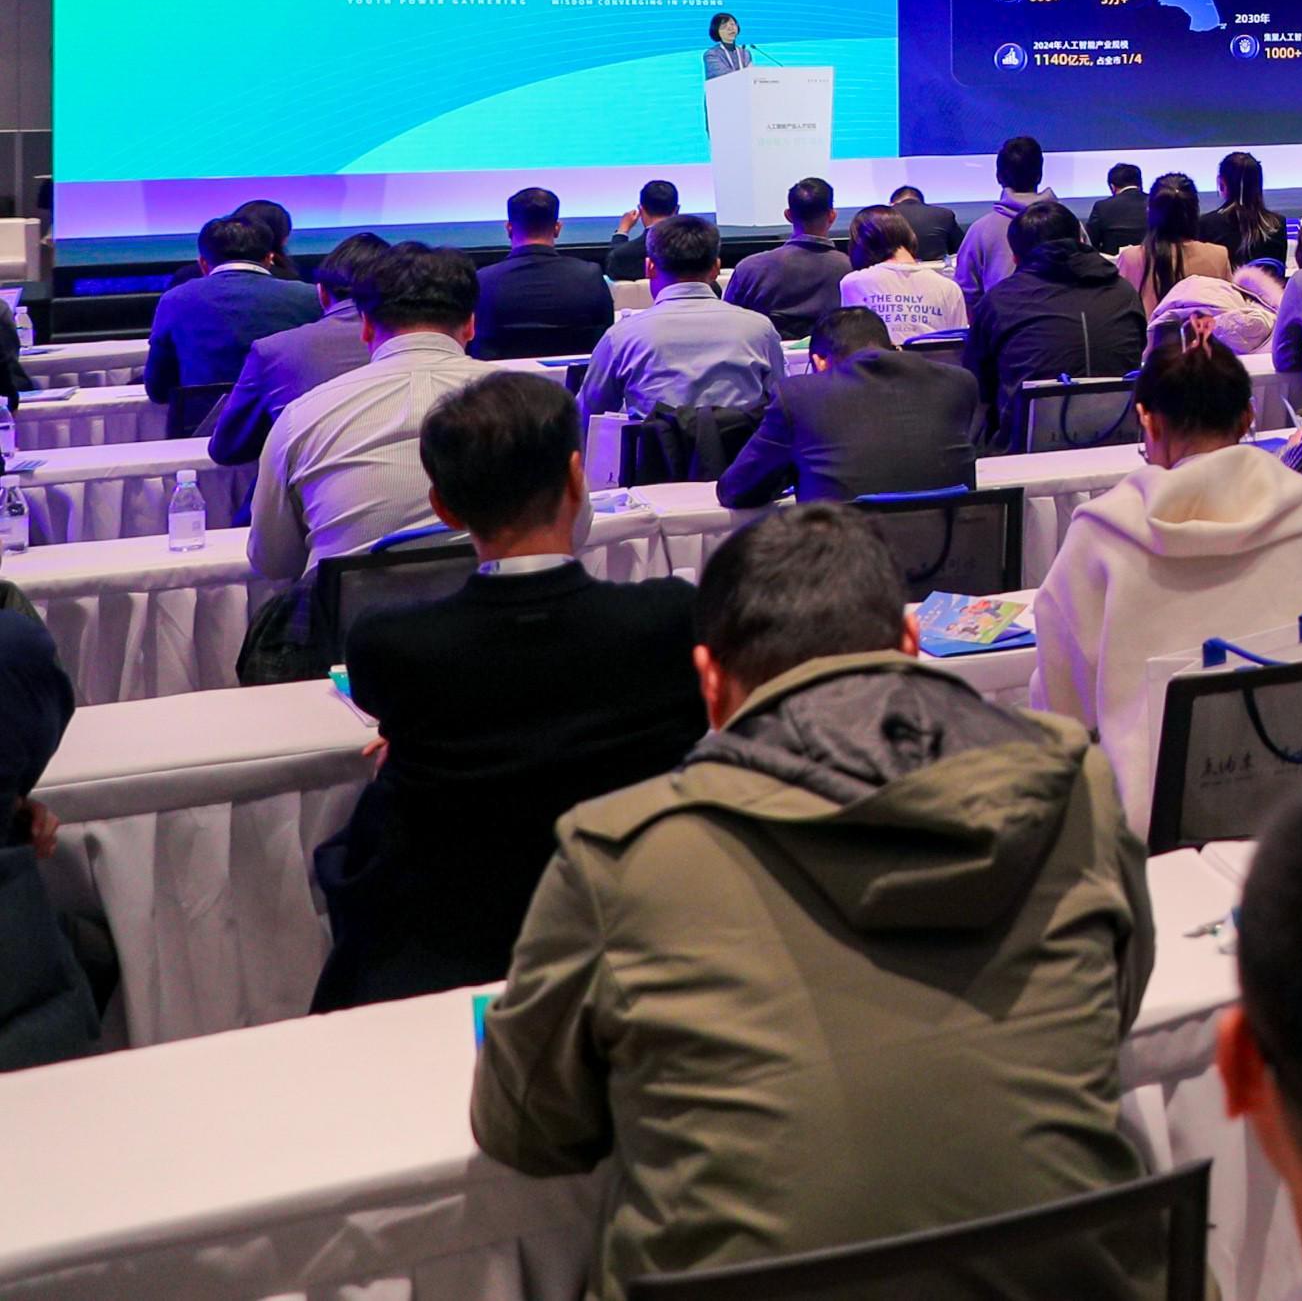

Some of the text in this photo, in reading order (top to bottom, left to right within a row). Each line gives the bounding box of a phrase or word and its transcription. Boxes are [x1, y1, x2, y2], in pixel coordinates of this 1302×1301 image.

[1235, 14, 1270, 24] 2030年
[1265, 48, 1302, 59] 1000+
[870, 295, 924, 303] THE ONLY
[906, 305, 943, 316] YOU'LL
